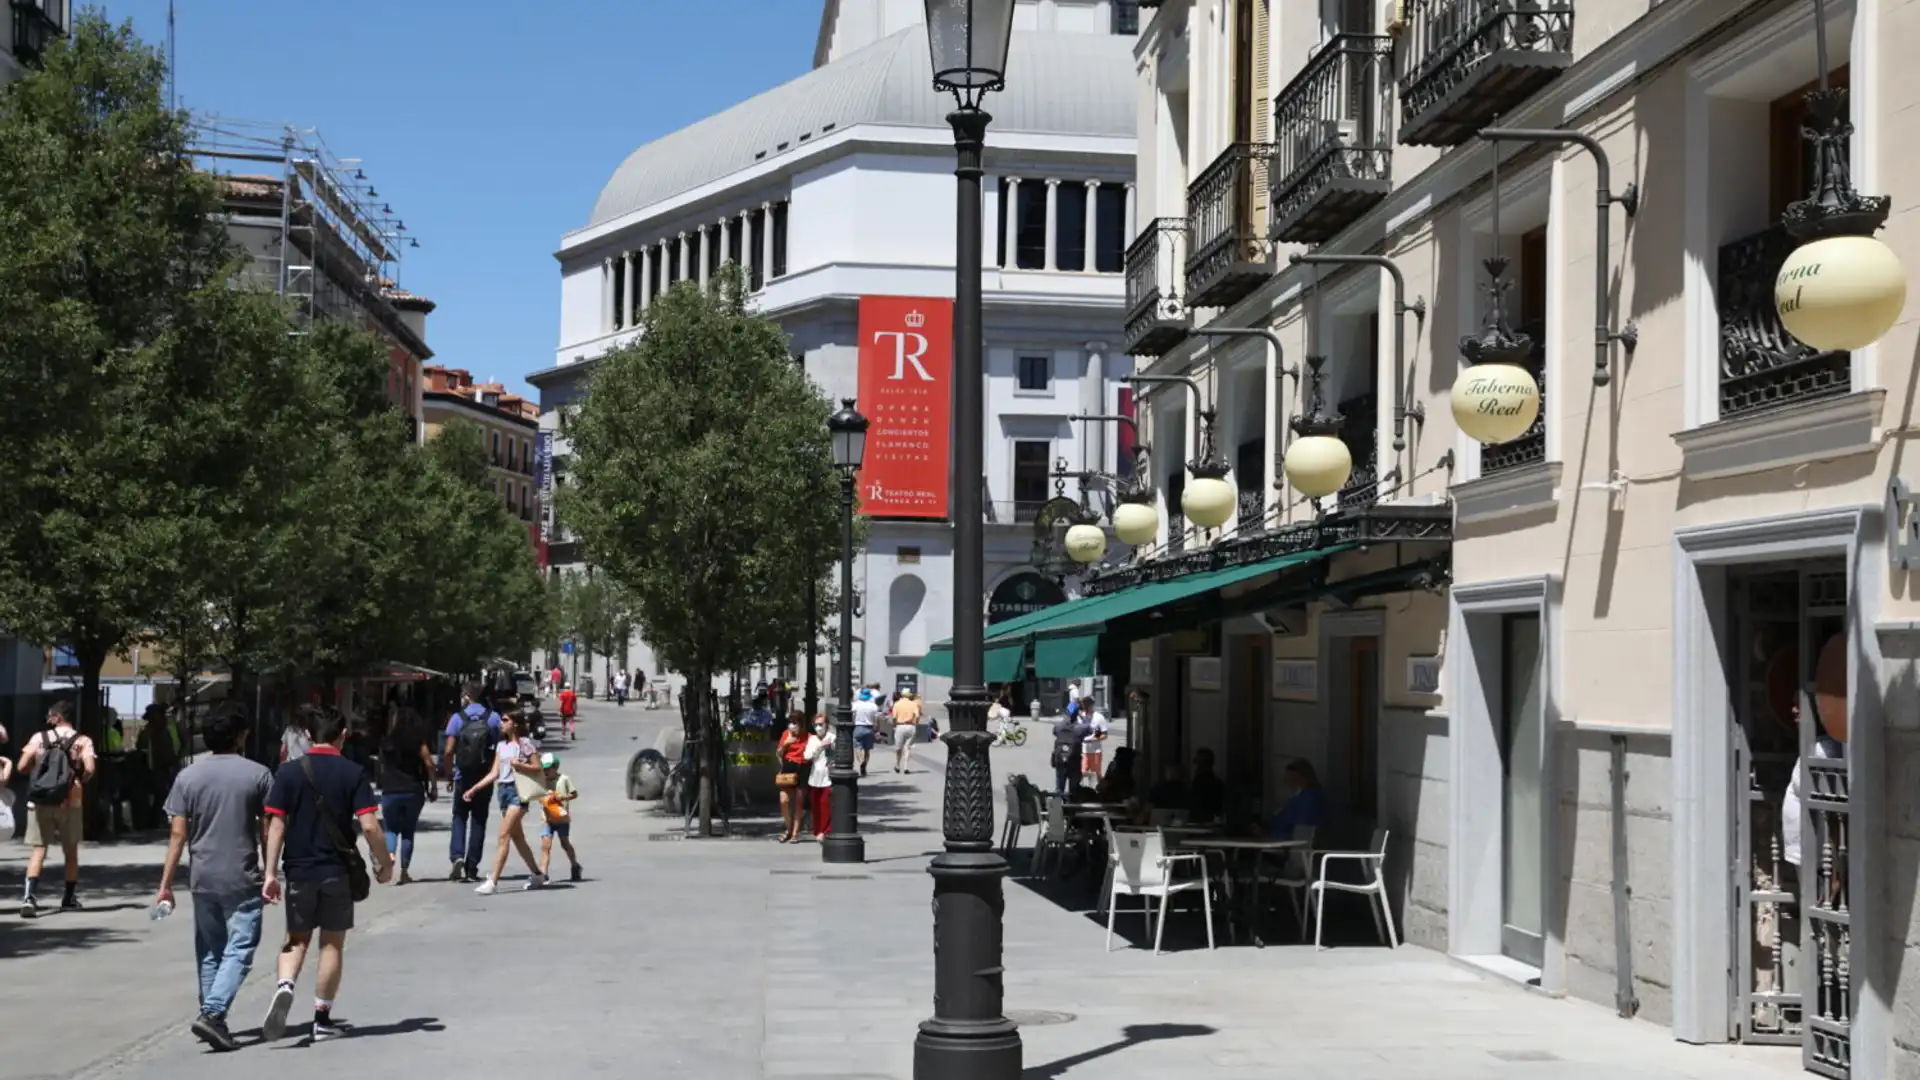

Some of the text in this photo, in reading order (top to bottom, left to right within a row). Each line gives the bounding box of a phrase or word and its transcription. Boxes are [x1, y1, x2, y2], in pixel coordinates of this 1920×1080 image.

[1465, 377, 1534, 396] Taberna
[1477, 397, 1525, 416] Real
[876, 428, 929, 437] CONCIERTOS
[876, 440, 929, 449] FLAMENCO
[991, 603, 1049, 613] STARBUC
